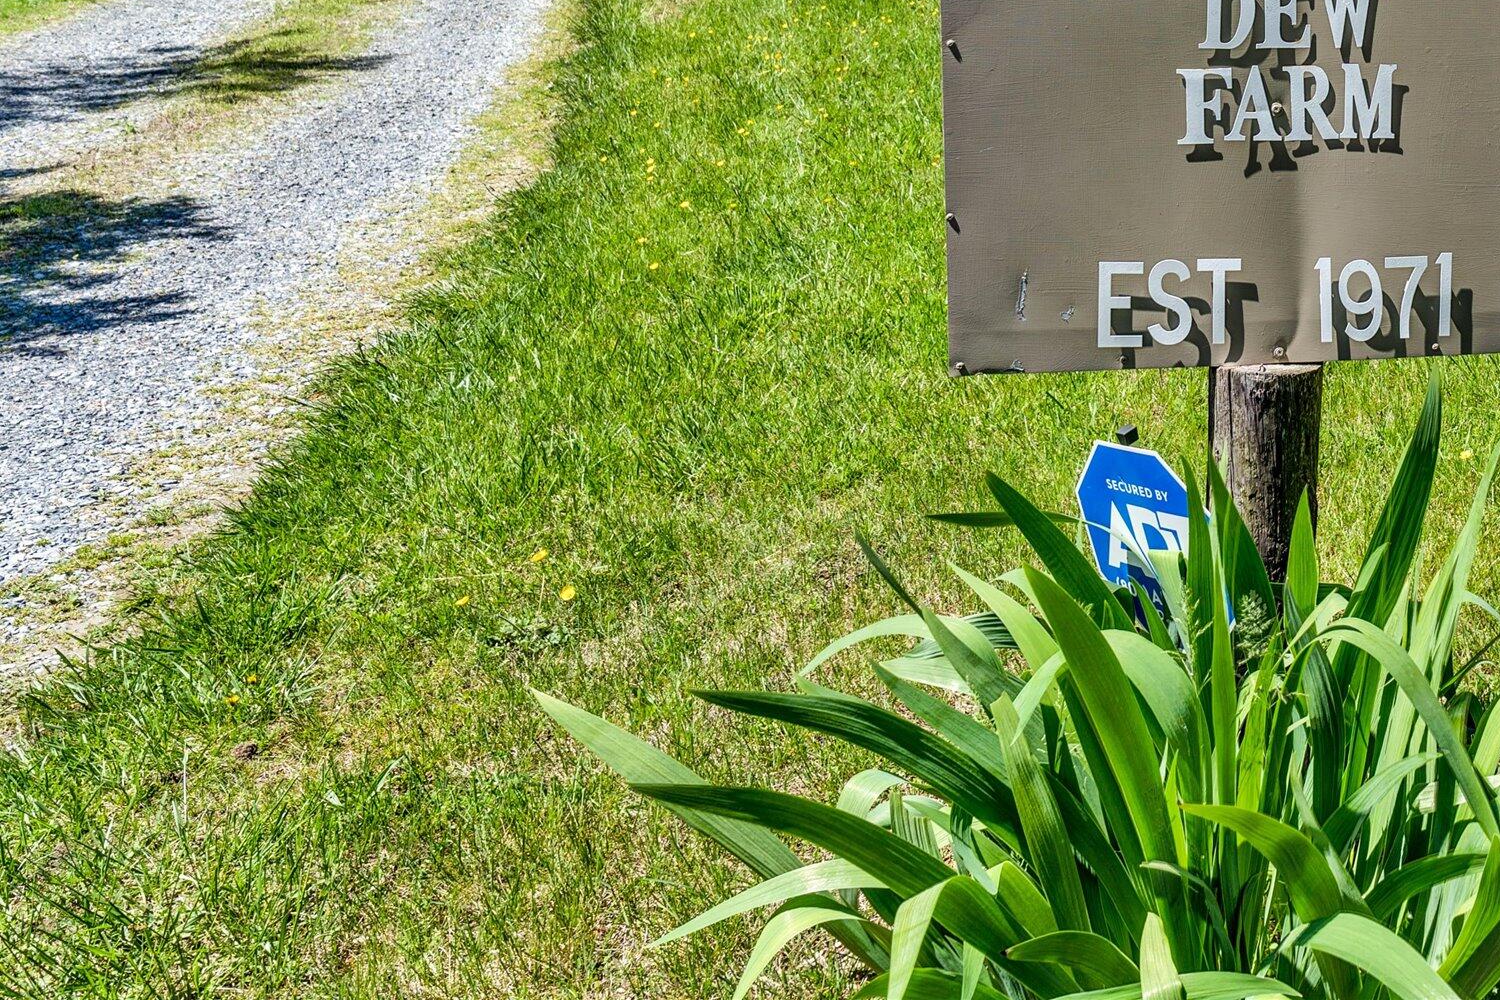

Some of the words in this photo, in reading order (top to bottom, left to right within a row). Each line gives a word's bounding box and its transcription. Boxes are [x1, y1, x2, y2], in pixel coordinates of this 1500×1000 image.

[1176, 64, 1397, 145] FARM
[1097, 257, 1242, 348] EST
[1314, 252, 1453, 343] 1971
[1105, 478, 1153, 499] SECURED
[1154, 489, 1168, 502] BY
